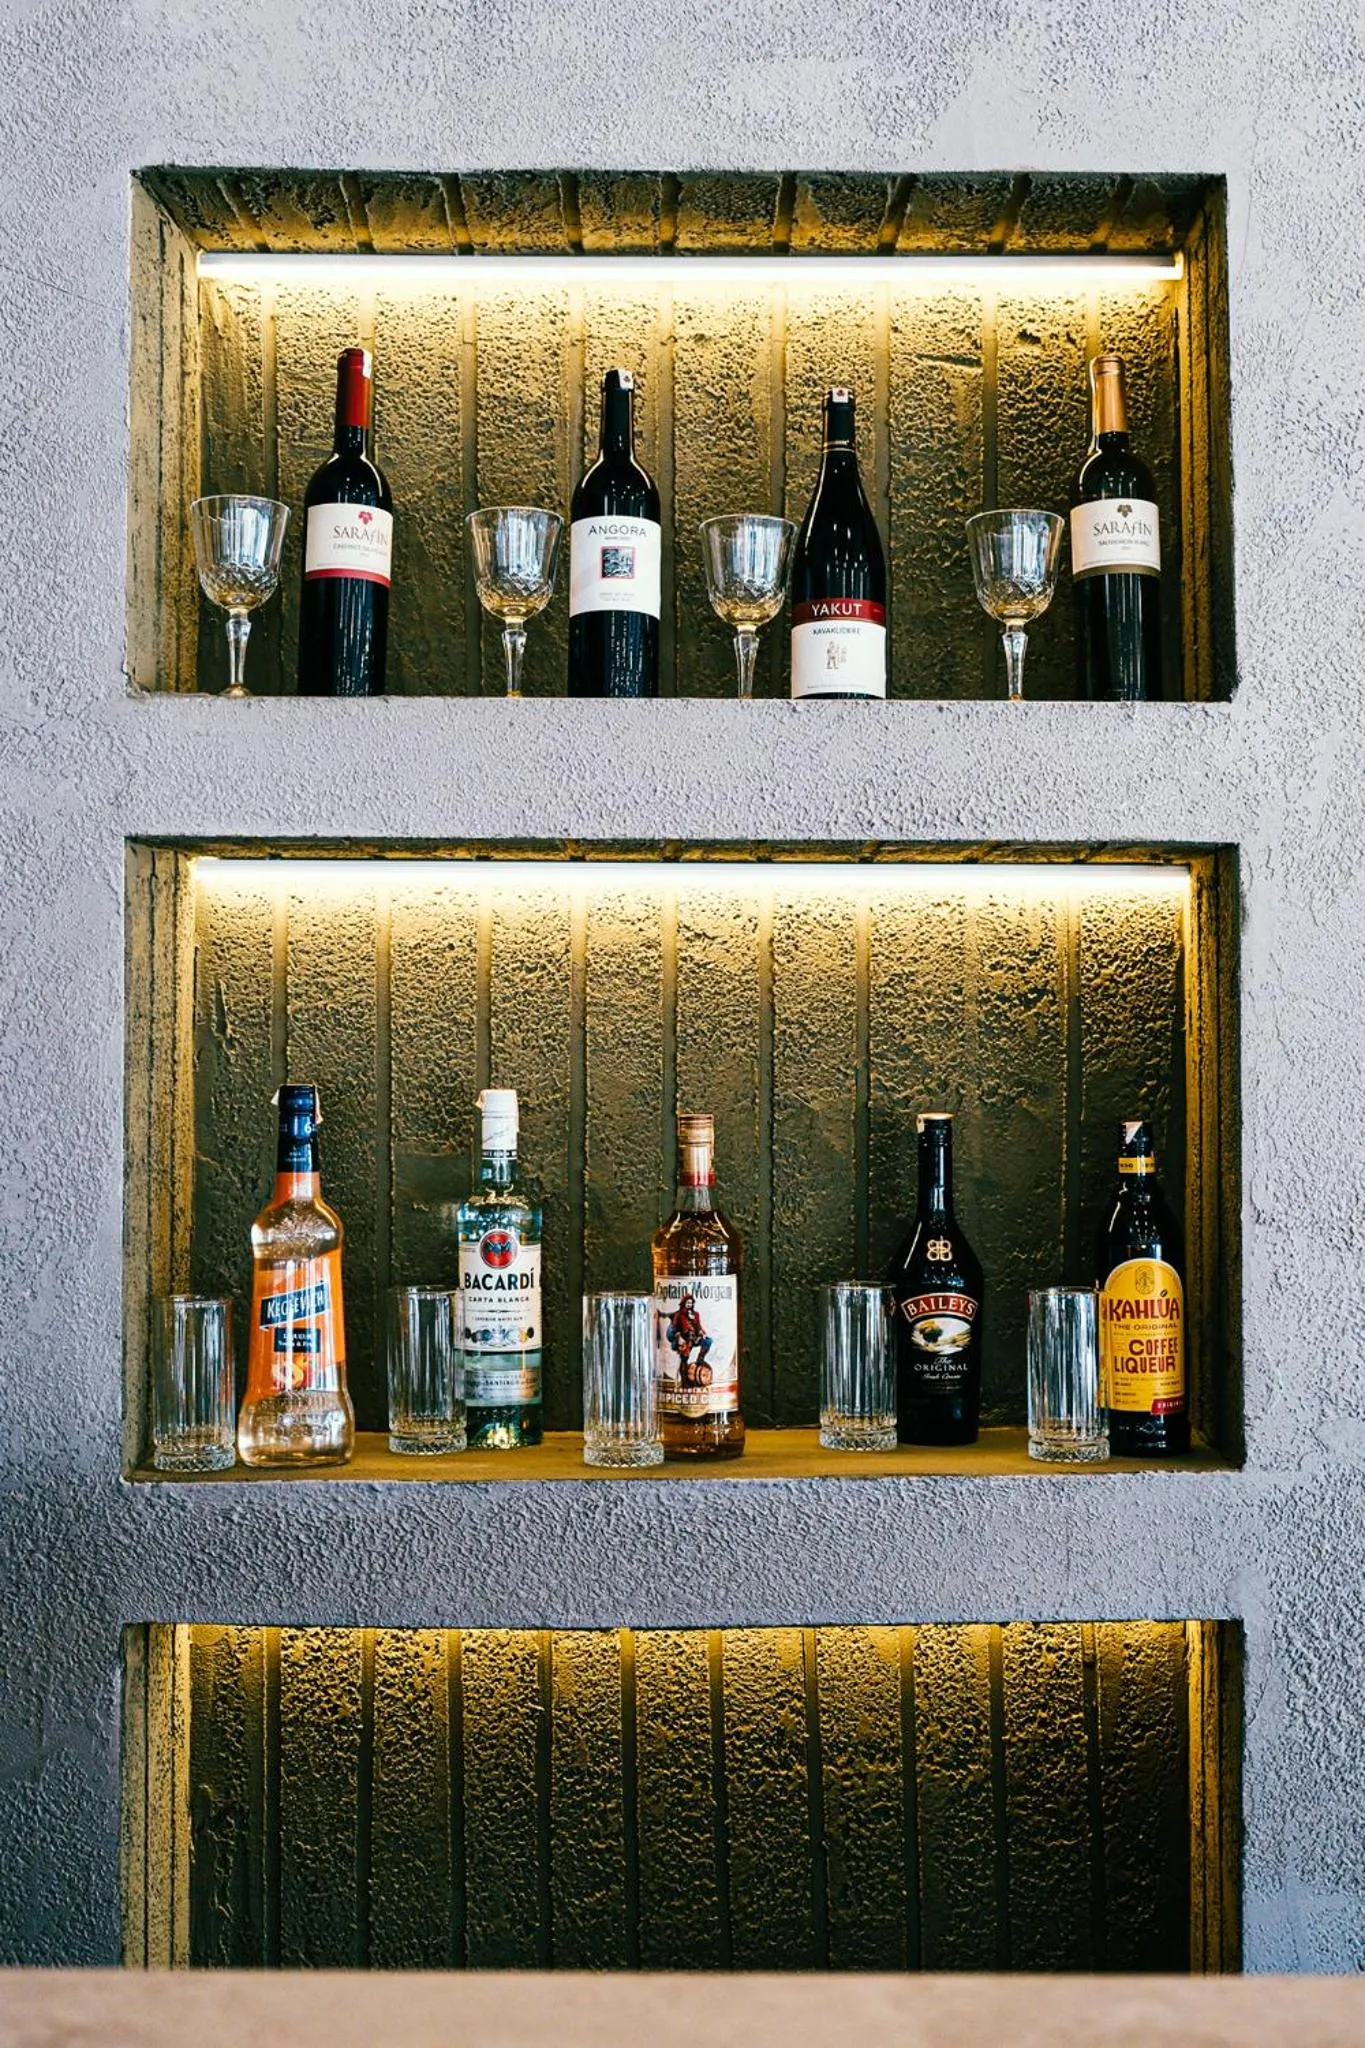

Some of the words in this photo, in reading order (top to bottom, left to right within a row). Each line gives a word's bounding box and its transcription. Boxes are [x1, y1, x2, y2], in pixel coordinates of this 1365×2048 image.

[588, 524, 647, 536] ANGORA
[811, 602, 863, 617] YAKUT
[464, 1266, 534, 1291] BACARDÍ
[689, 1280, 732, 1302] Morgan
[907, 1296, 974, 1316] BAILEYS
[1129, 1337, 1179, 1356] COFFEE
[913, 1363, 969, 1372] ORIGINAL
[1114, 1355, 1176, 1373] LIQUEUR
